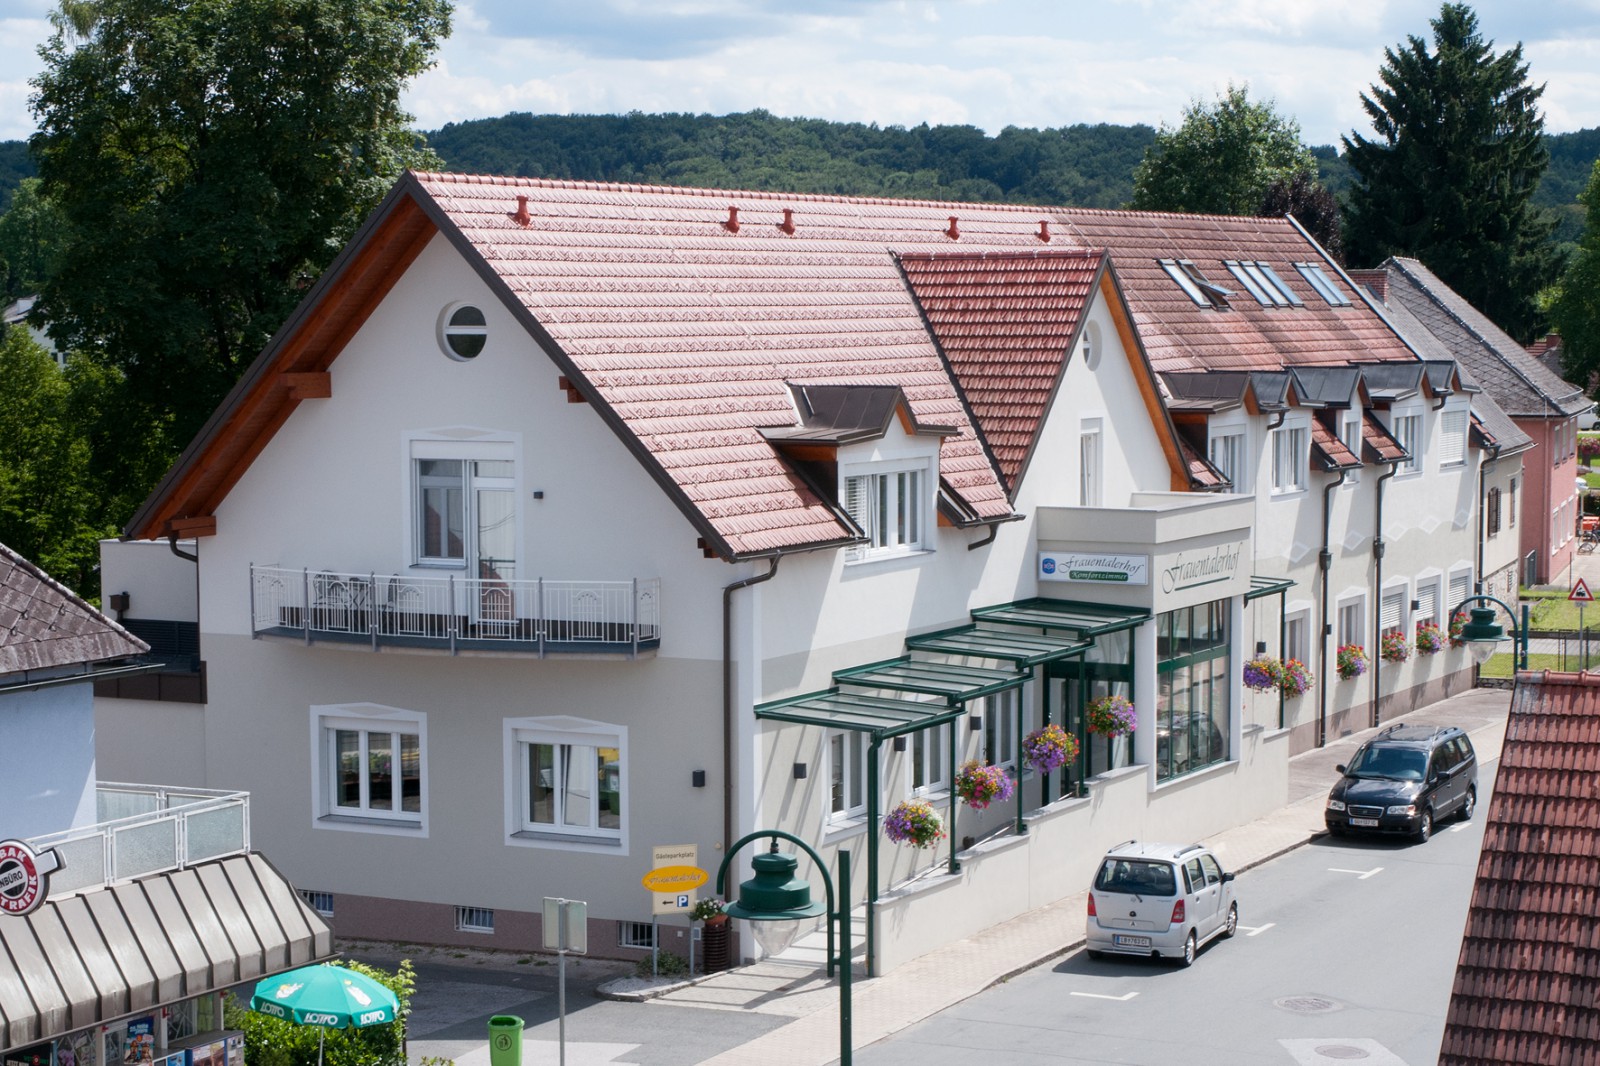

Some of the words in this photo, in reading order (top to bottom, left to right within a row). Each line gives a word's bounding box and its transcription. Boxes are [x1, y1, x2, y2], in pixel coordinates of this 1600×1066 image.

[1058, 555, 1145, 577] Frauentalerhof
[1162, 541, 1244, 595] Frauentalerhof
[1071, 571, 1128, 581] Komfortzimmer
[0, 870, 23, 888] NBÜRO
[0, 875, 37, 910] TRAFIK
[678, 895, 687, 907] P
[260, 1001, 285, 1018] LOTTO
[360, 1010, 385, 1025] LOTTO
[303, 1012, 338, 1026] LOTTO
